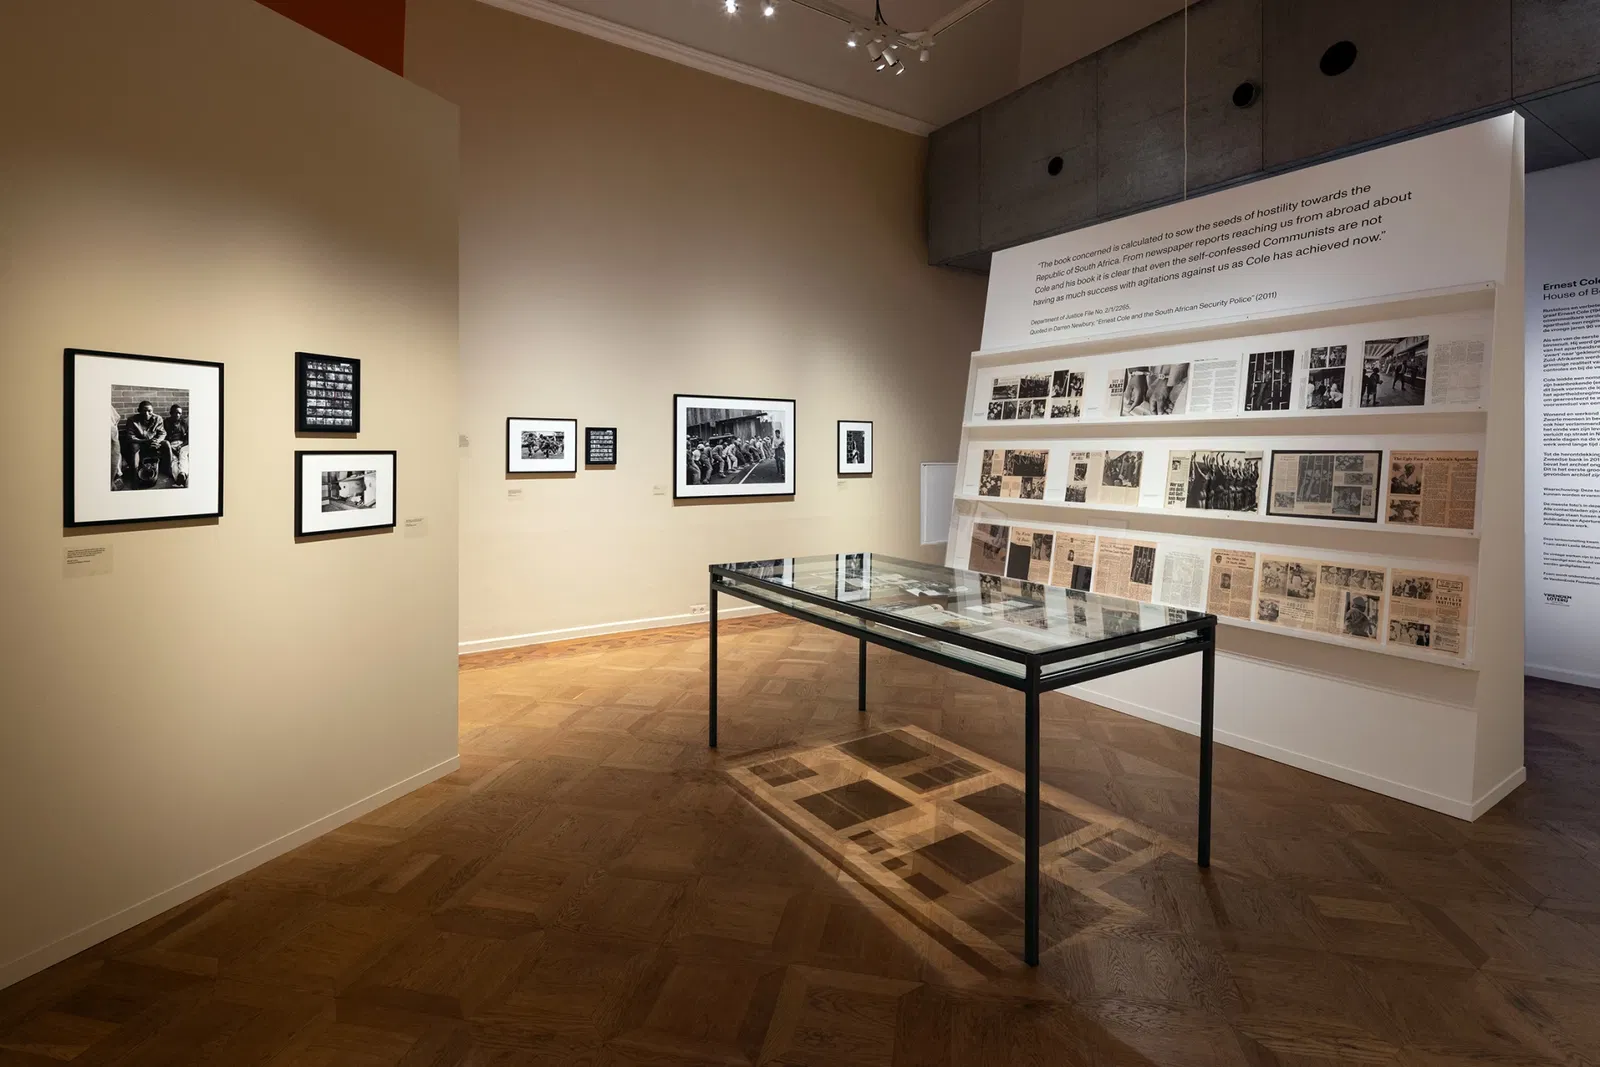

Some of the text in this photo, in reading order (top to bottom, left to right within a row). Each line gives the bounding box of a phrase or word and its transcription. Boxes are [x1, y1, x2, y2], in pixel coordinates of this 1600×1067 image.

[1036, 269, 1065, 282] Republic
[1074, 263, 1096, 273] South
[1097, 259, 1121, 269] Africa.
[1123, 254, 1143, 263] From
[1146, 241, 1193, 258] newspaper
[1195, 233, 1229, 247] reports
[1232, 223, 1278, 238] reaching
[1280, 220, 1293, 228] us
[1296, 212, 1323, 224] from
[1326, 200, 1370, 218] abroad
[1373, 191, 1412, 208] about
[1054, 256, 1071, 265] book
[1072, 246, 1111, 261] concerned
[1121, 234, 1163, 250] calculated
[1176, 227, 1194, 236] sow
[1196, 223, 1211, 232] the
[1213, 216, 1242, 228] seeds
[1244, 211, 1255, 220] of
[1257, 202, 1298, 218] hostility
[1301, 190, 1348, 207] towards
[1351, 185, 1371, 196] the
[1077, 276, 1095, 285] book
[1111, 269, 1130, 279] clear
[1132, 265, 1148, 274] that
[1150, 261, 1170, 270] even
[1172, 258, 1186, 266] the
[1188, 241, 1260, 262] self-confessed
[1263, 226, 1335, 247] Communists
[1338, 221, 1358, 232] are
[1362, 215, 1382, 227] not
[1033, 297, 1055, 306] having
[1066, 290, 1086, 299] much
[1087, 284, 1118, 296] success
[1119, 279, 1136, 290] with
[1138, 273, 1179, 287] agitations
[1181, 265, 1215, 279] against
[1232, 260, 1243, 268] as
[1246, 255, 1270, 265] Cole
[1273, 252, 1292, 261] has
[1296, 238, 1349, 256] achieved
[1544, 278, 1600, 290] Ernest Col
[1030, 326, 1047, 335] Quoted
[1155, 307, 1173, 316] South
[1175, 304, 1198, 313] African
[1199, 300, 1228, 309] Security
[1256, 291, 1277, 301] (2011)
[1031, 317, 1059, 325] Department
